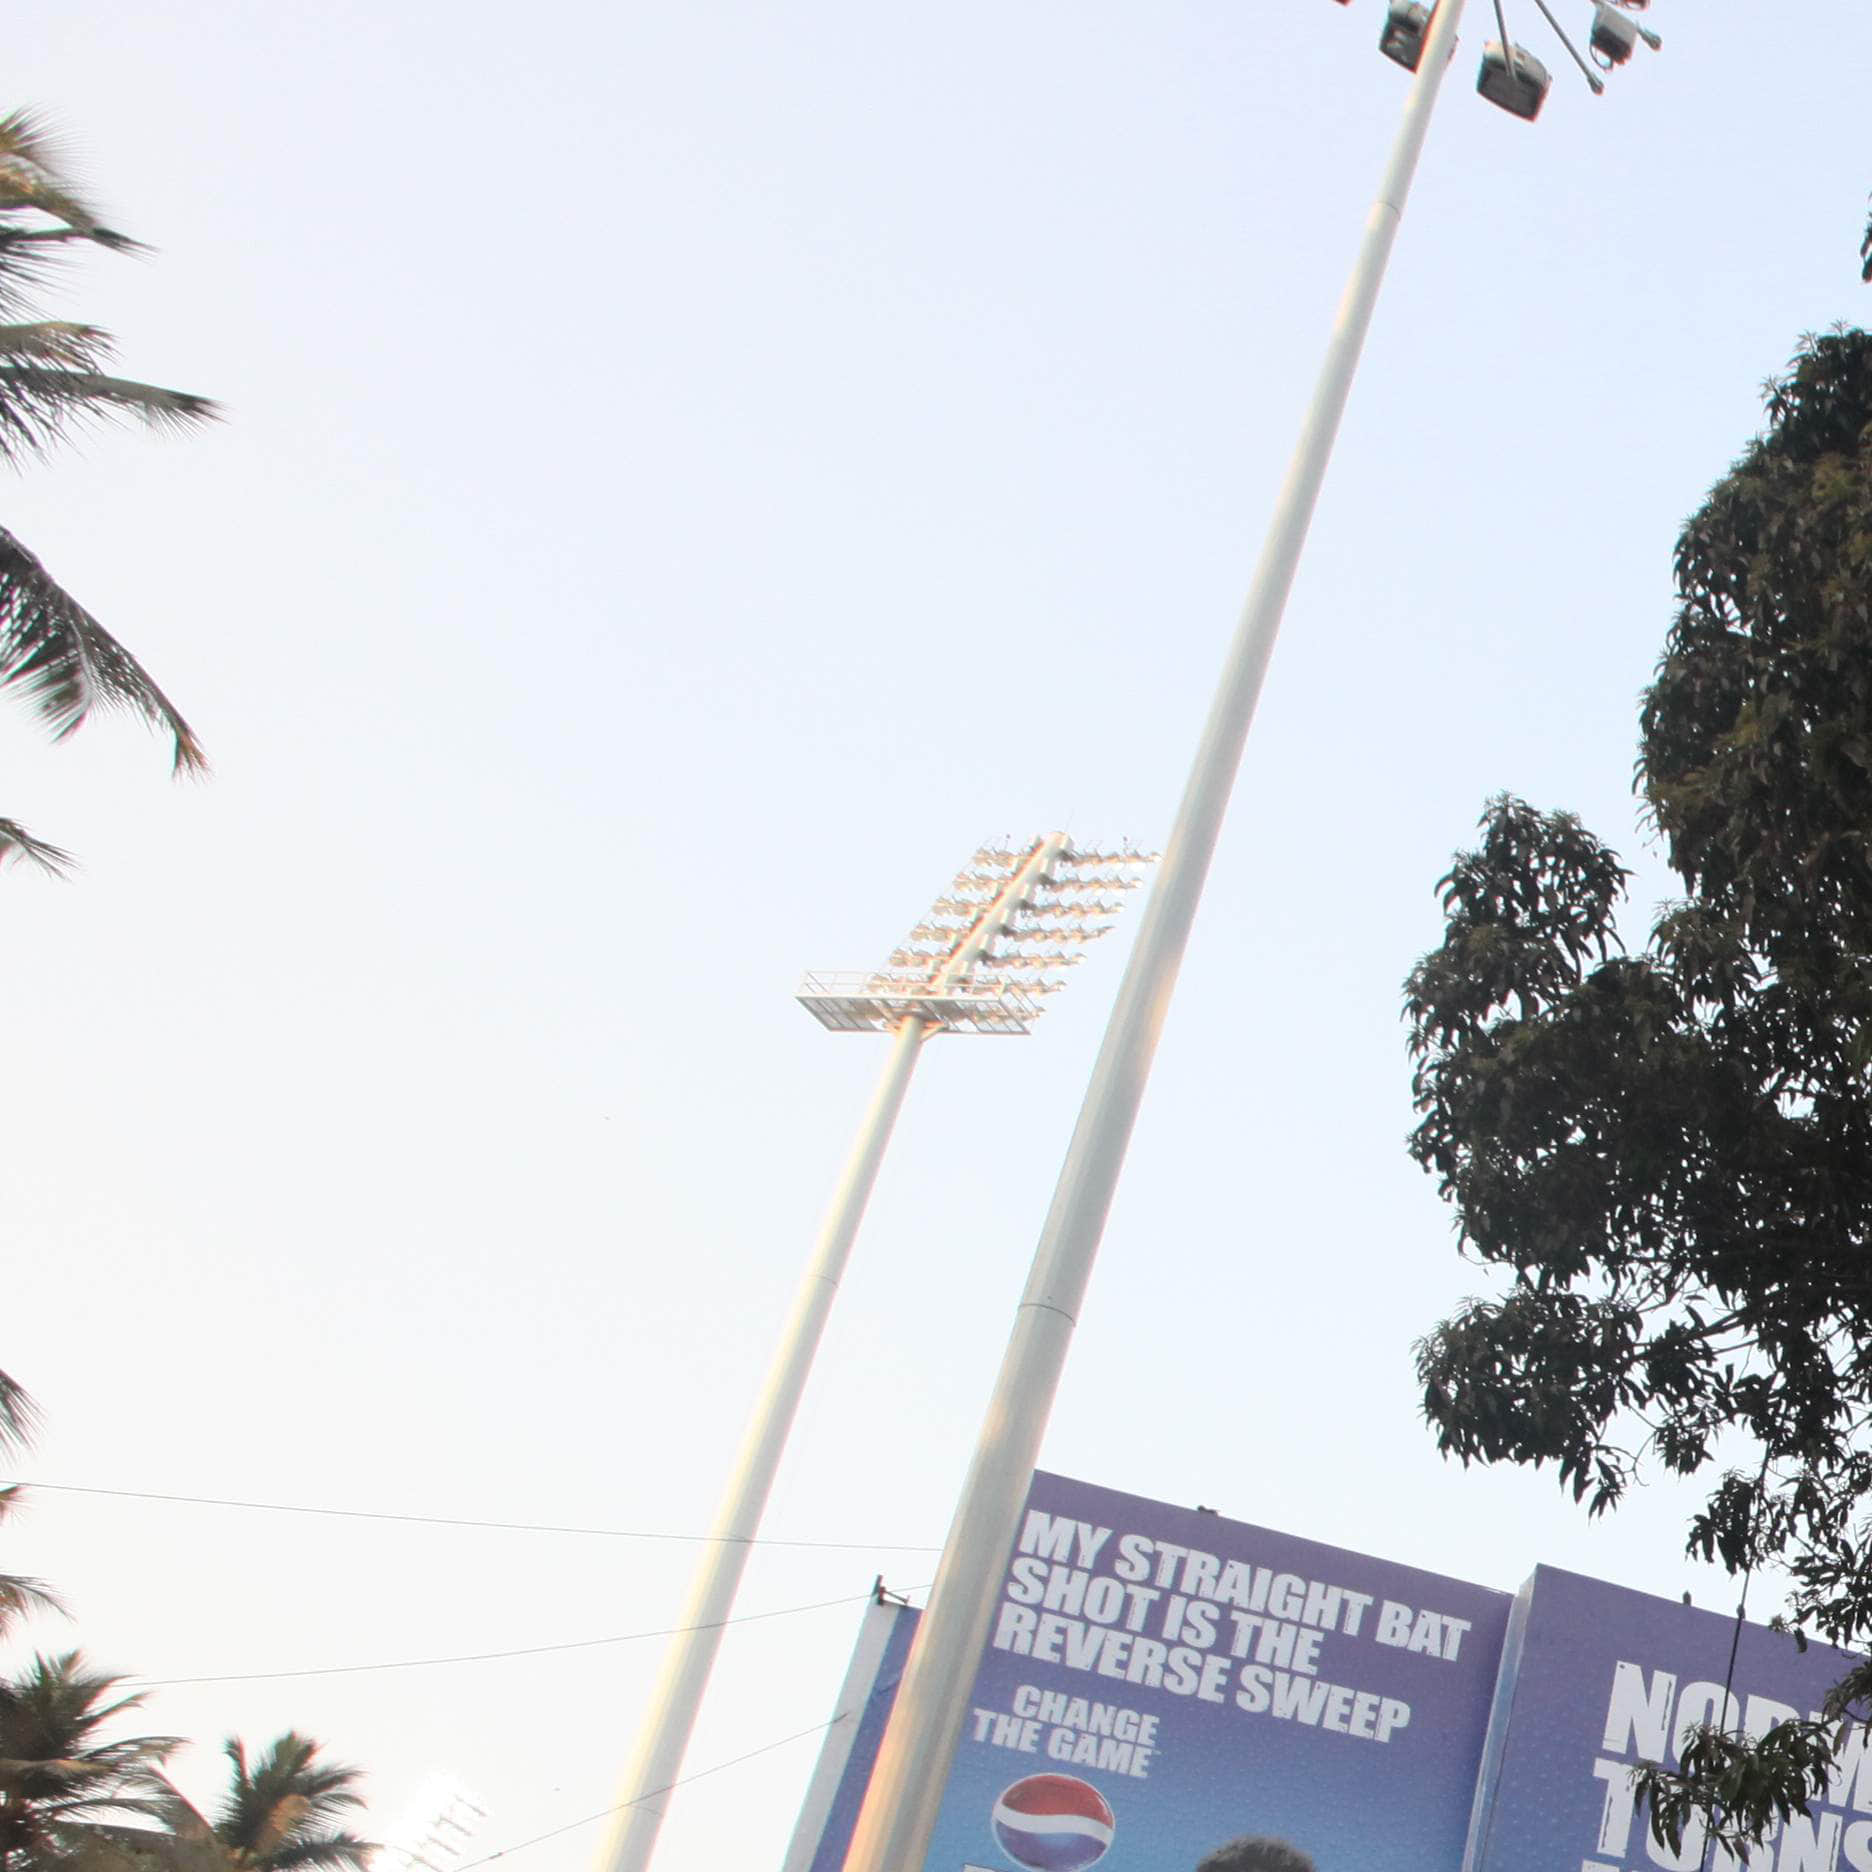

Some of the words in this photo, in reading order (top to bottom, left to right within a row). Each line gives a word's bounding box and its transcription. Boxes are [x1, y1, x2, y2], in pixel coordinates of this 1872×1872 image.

[1007, 1557, 1161, 1633] SHOT
[1161, 1594, 1220, 1649] IS
[1230, 1609, 1325, 1676] THE
[1018, 1509, 1113, 1569] MY
[1114, 1534, 1374, 1636] STRAIGHT
[1375, 1599, 1472, 1662] BAT
[993, 1601, 1232, 1704] REVERSE
[1235, 1664, 1411, 1743] SWEEP
[1012, 1684, 1160, 1747] CHANGE
[973, 1708, 1042, 1753] THE
[1047, 1727, 1153, 1777] GAME
